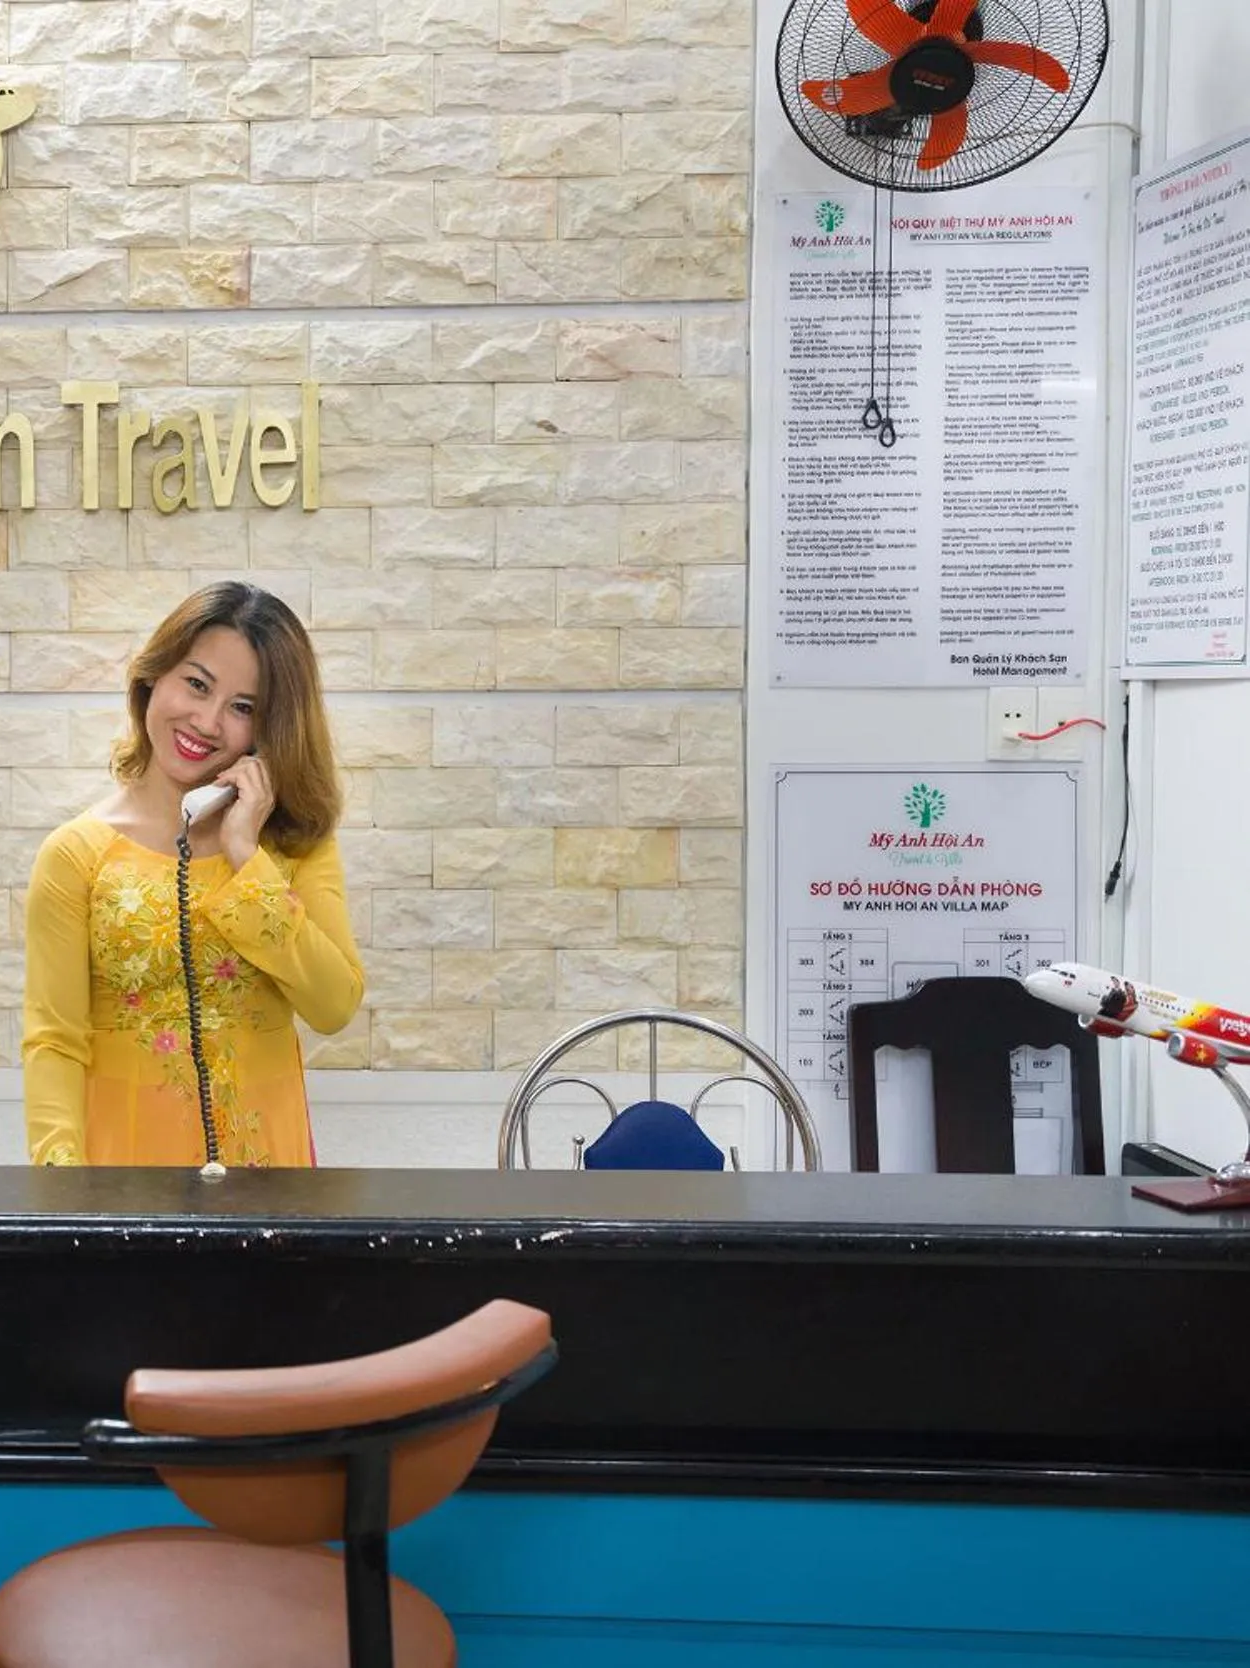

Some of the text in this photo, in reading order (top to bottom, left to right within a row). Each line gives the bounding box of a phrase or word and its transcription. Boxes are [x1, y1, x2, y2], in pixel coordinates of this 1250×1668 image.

[61, 378, 320, 514] Travel
[973, 666, 1068, 678] Hotel Management
[895, 832, 928, 848] Anh
[961, 832, 985, 848] An
[843, 901, 863, 912] MY
[864, 901, 892, 912] ANH
[920, 901, 938, 912] AN
[942, 901, 978, 912] VILLA
[981, 901, 1009, 911] MAP
